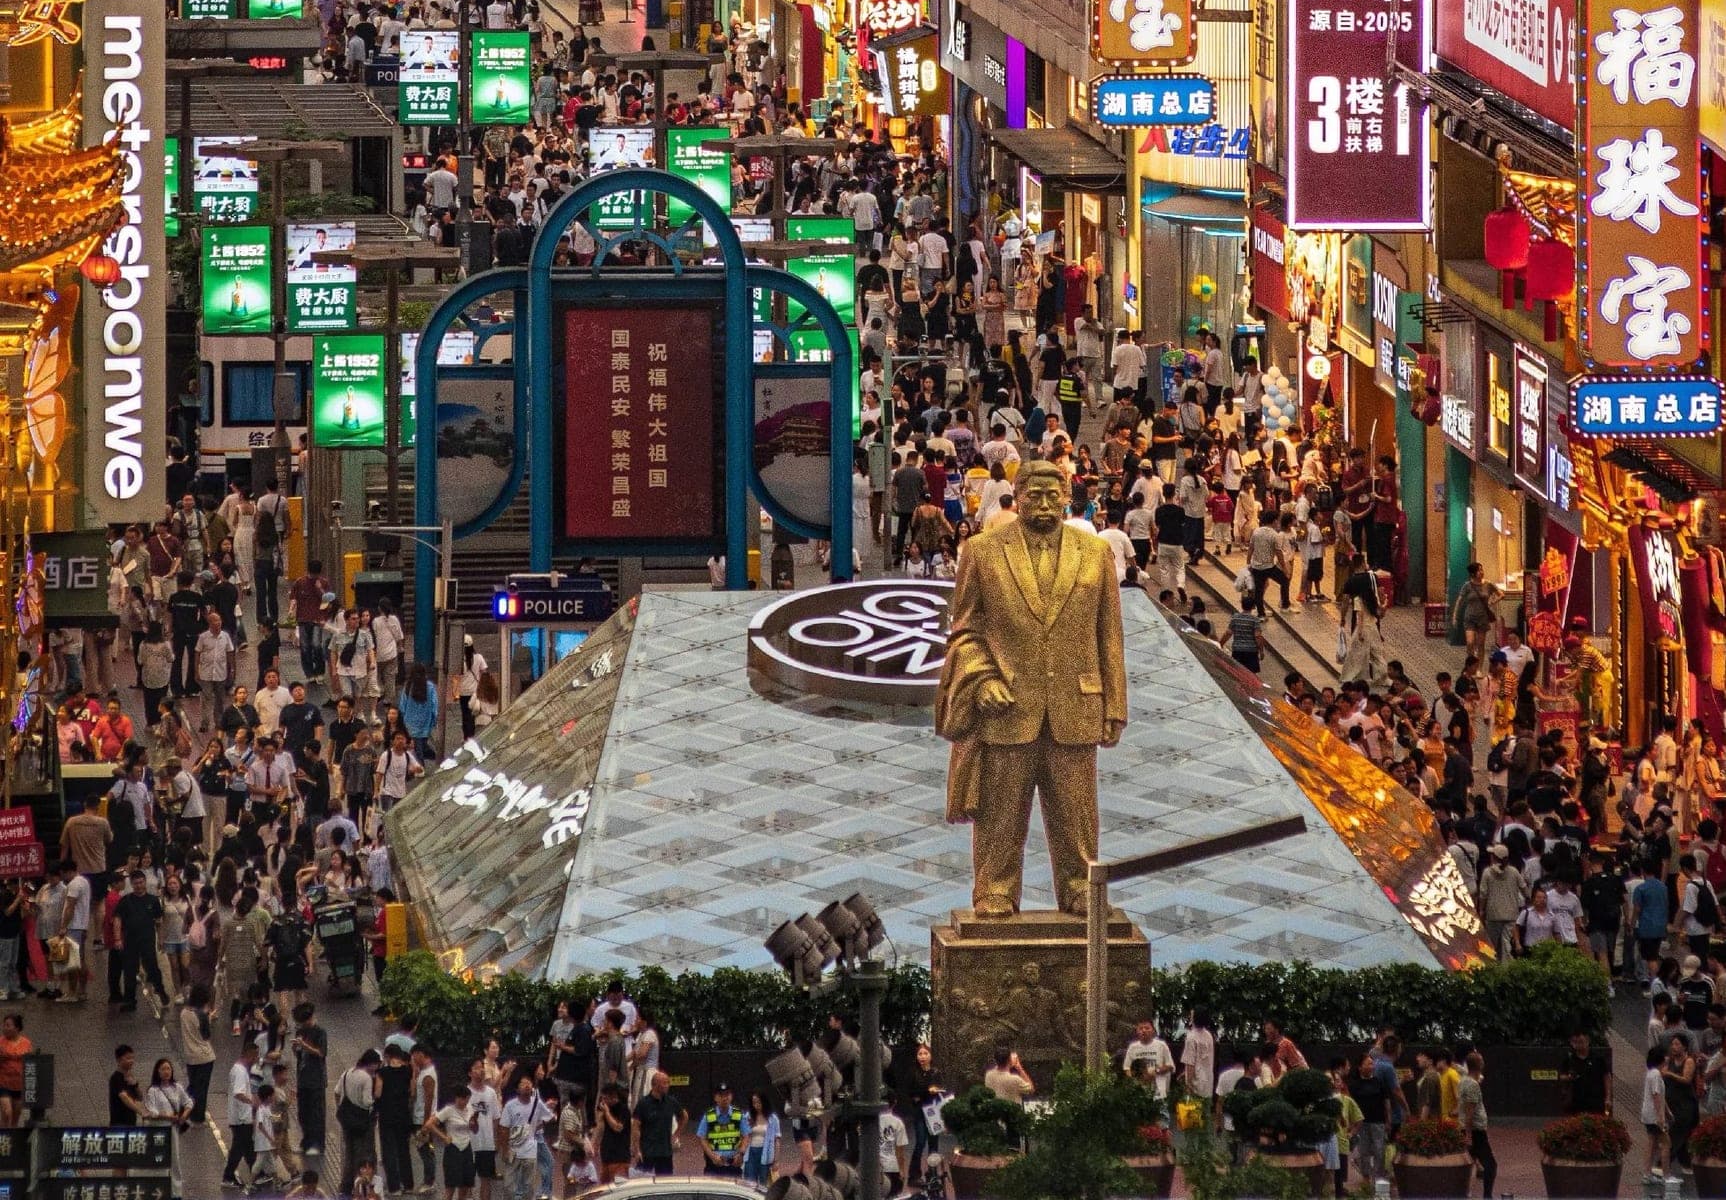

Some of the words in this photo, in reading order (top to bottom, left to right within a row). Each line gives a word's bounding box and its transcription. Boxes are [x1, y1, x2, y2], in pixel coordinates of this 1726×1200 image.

[405, 86, 451, 102] 费大厨
[1102, 90, 1212, 117] 湖南总店
[1345, 117, 1383, 134] 前右
[1345, 137, 1383, 153] 扶梯
[295, 287, 349, 306] 费大厨
[611, 330, 632, 418] 国泰民安
[647, 343, 668, 488] 祝福伟大祖国
[1582, 394, 1718, 424] 湖南总店
[611, 429, 632, 518] 繁荣昌盛
[524, 600, 584, 615] POLICE
[61, 1132, 148, 1155] 解放西路
